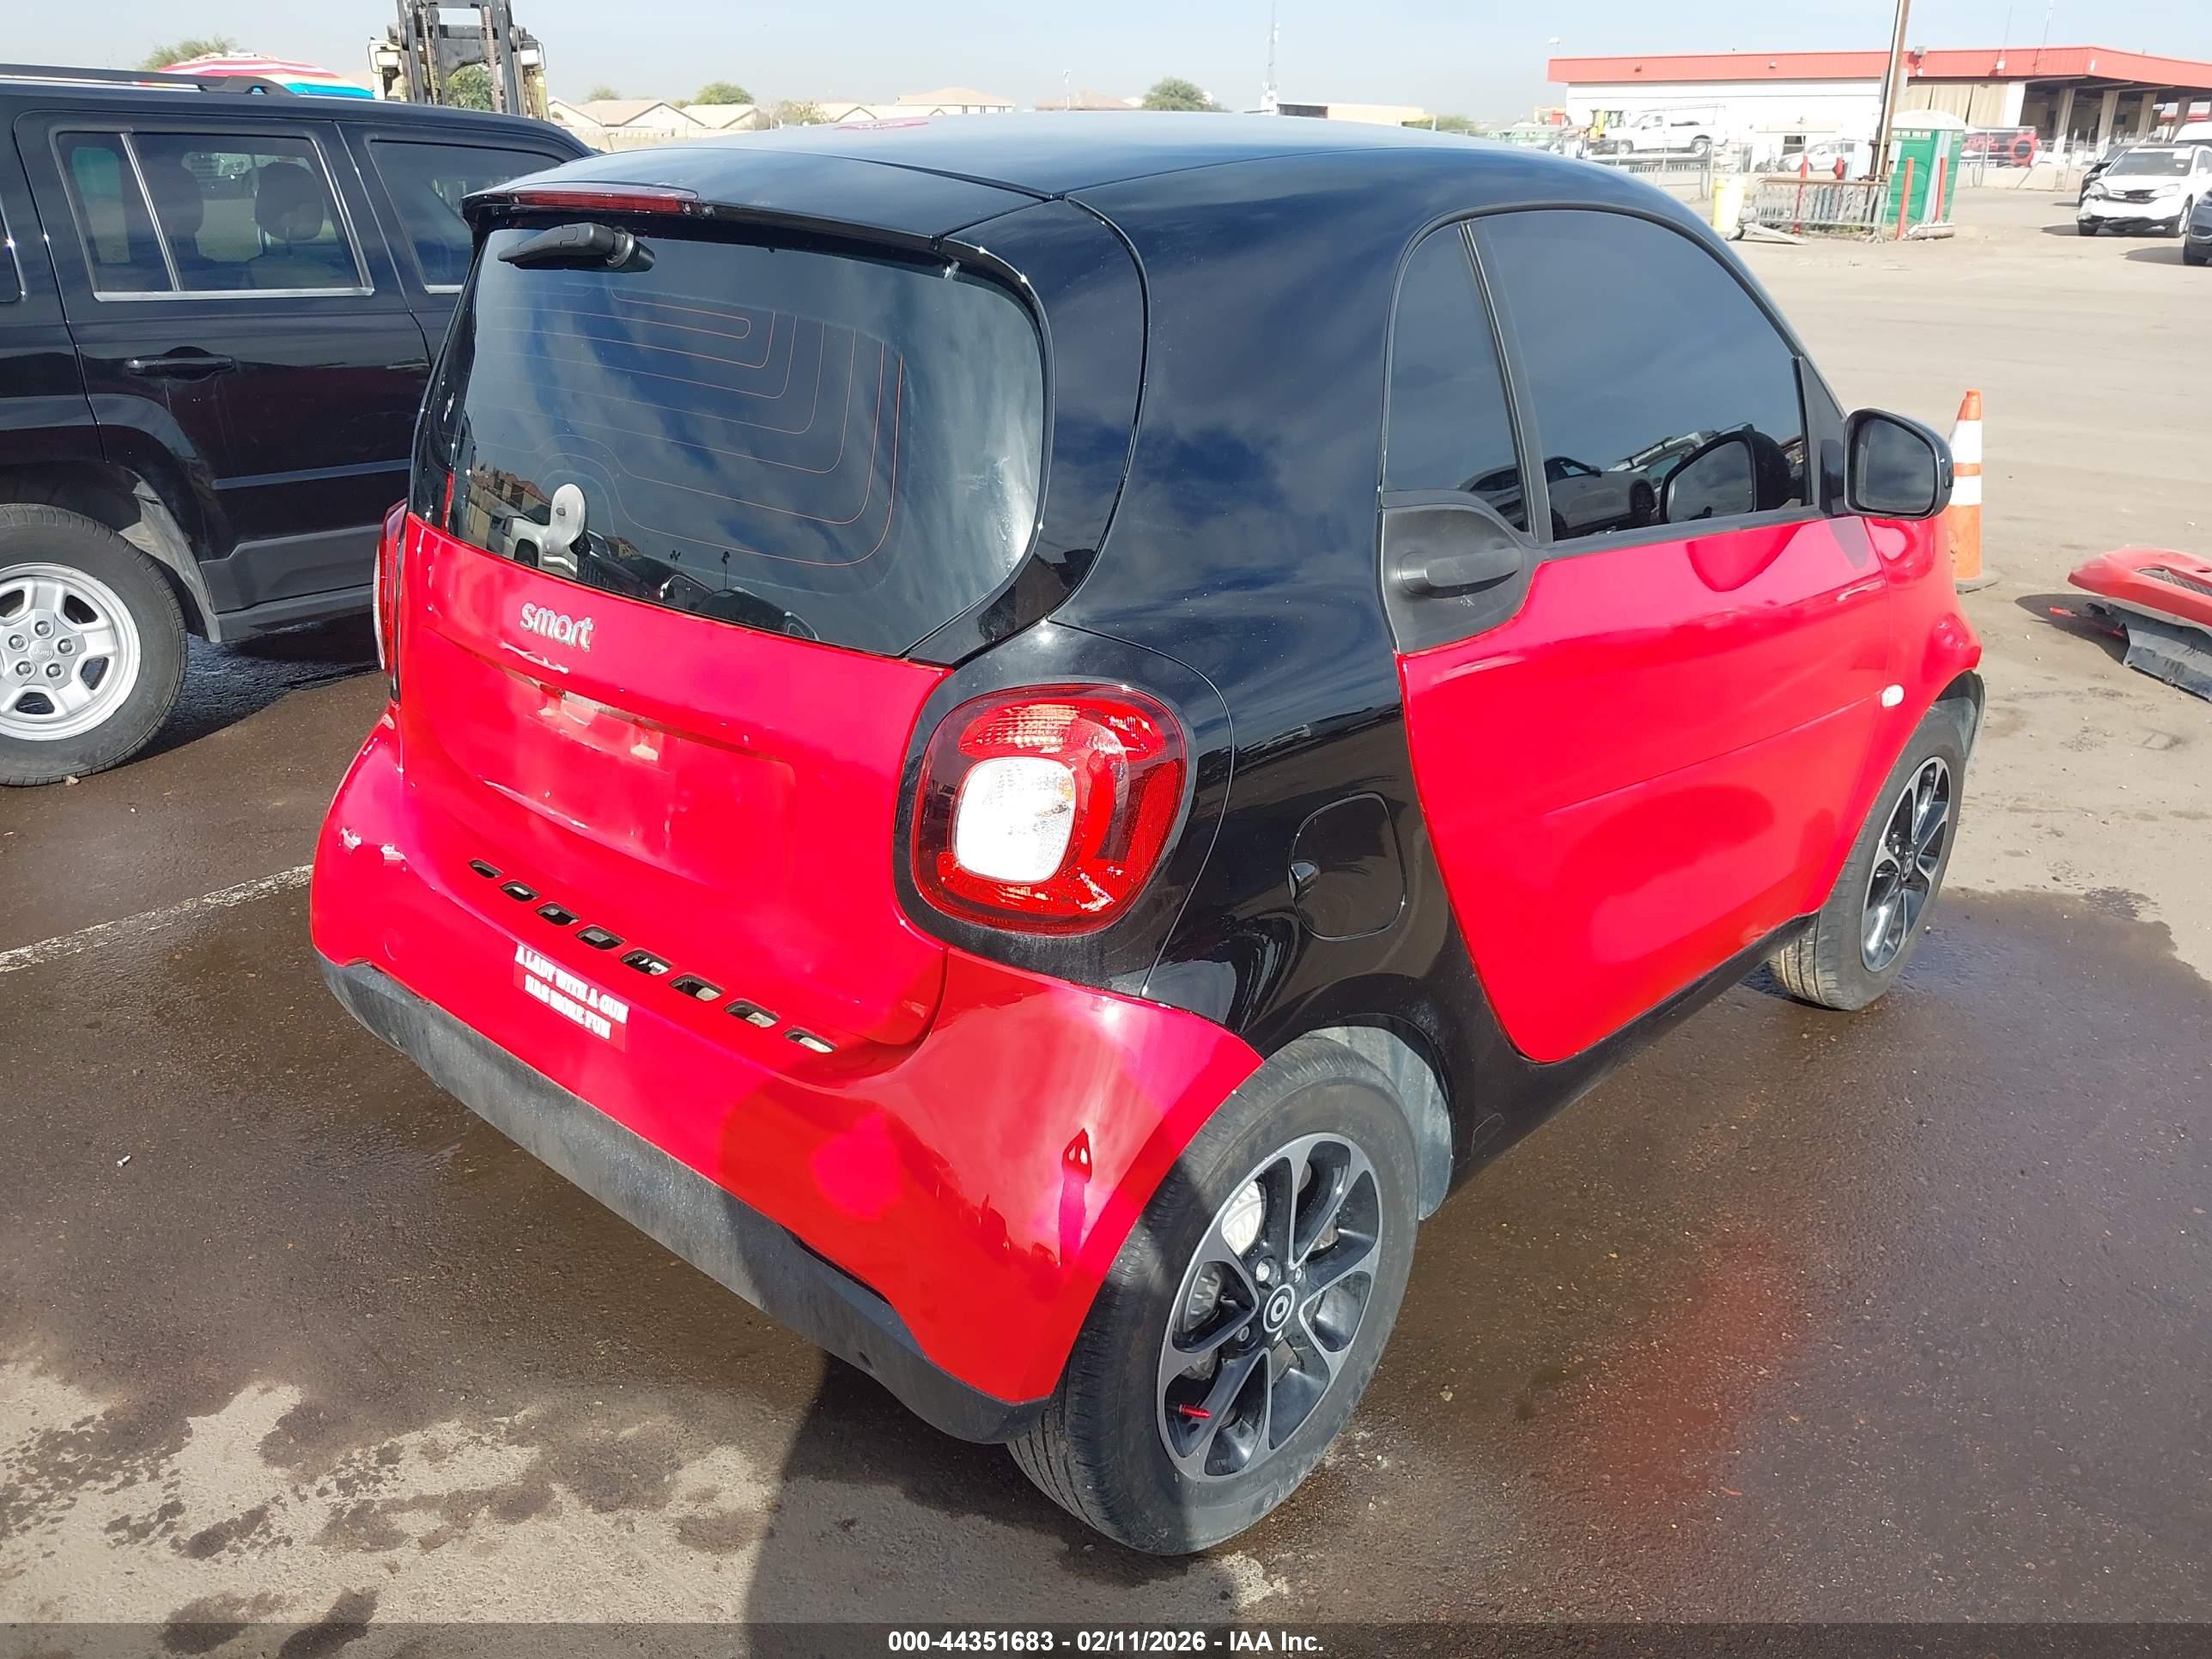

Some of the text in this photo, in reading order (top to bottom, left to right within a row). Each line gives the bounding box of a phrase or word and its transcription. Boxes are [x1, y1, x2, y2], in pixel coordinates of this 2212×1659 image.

[520, 602, 594, 653] smart
[515, 945, 629, 1024] A LADY WITH A GUN
[525, 974, 611, 1039] HAS MORE FUN
